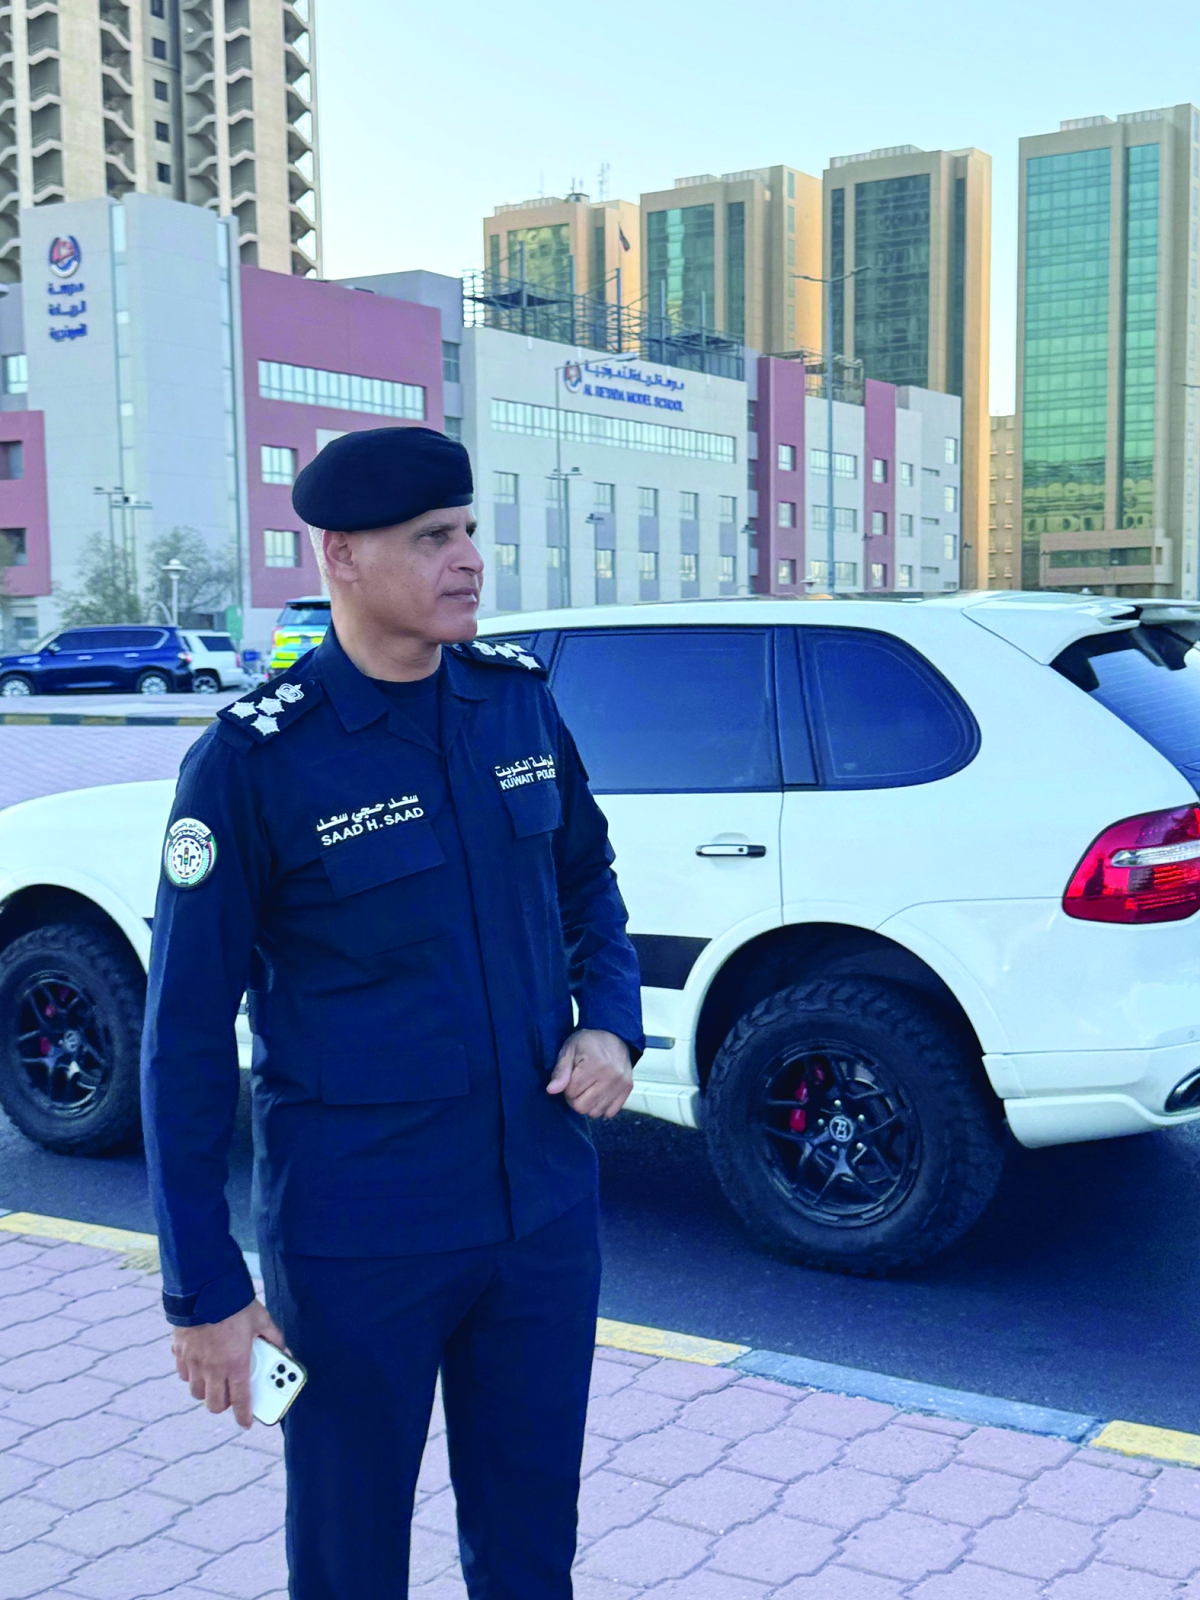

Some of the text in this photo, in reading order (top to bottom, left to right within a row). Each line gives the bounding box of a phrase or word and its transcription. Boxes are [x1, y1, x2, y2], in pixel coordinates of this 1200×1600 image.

[48, 283, 84, 296] مدرسة
[583, 384, 593, 397] AL
[626, 391, 652, 406] MODEL
[654, 396, 684, 412] SCHOOL
[494, 754, 554, 778] شرطة الكويت
[499, 768, 557, 791] KUWAIT POLICE
[316, 794, 419, 832] سعد حجي سعد
[321, 807, 425, 846] SAAD H. SAAD
